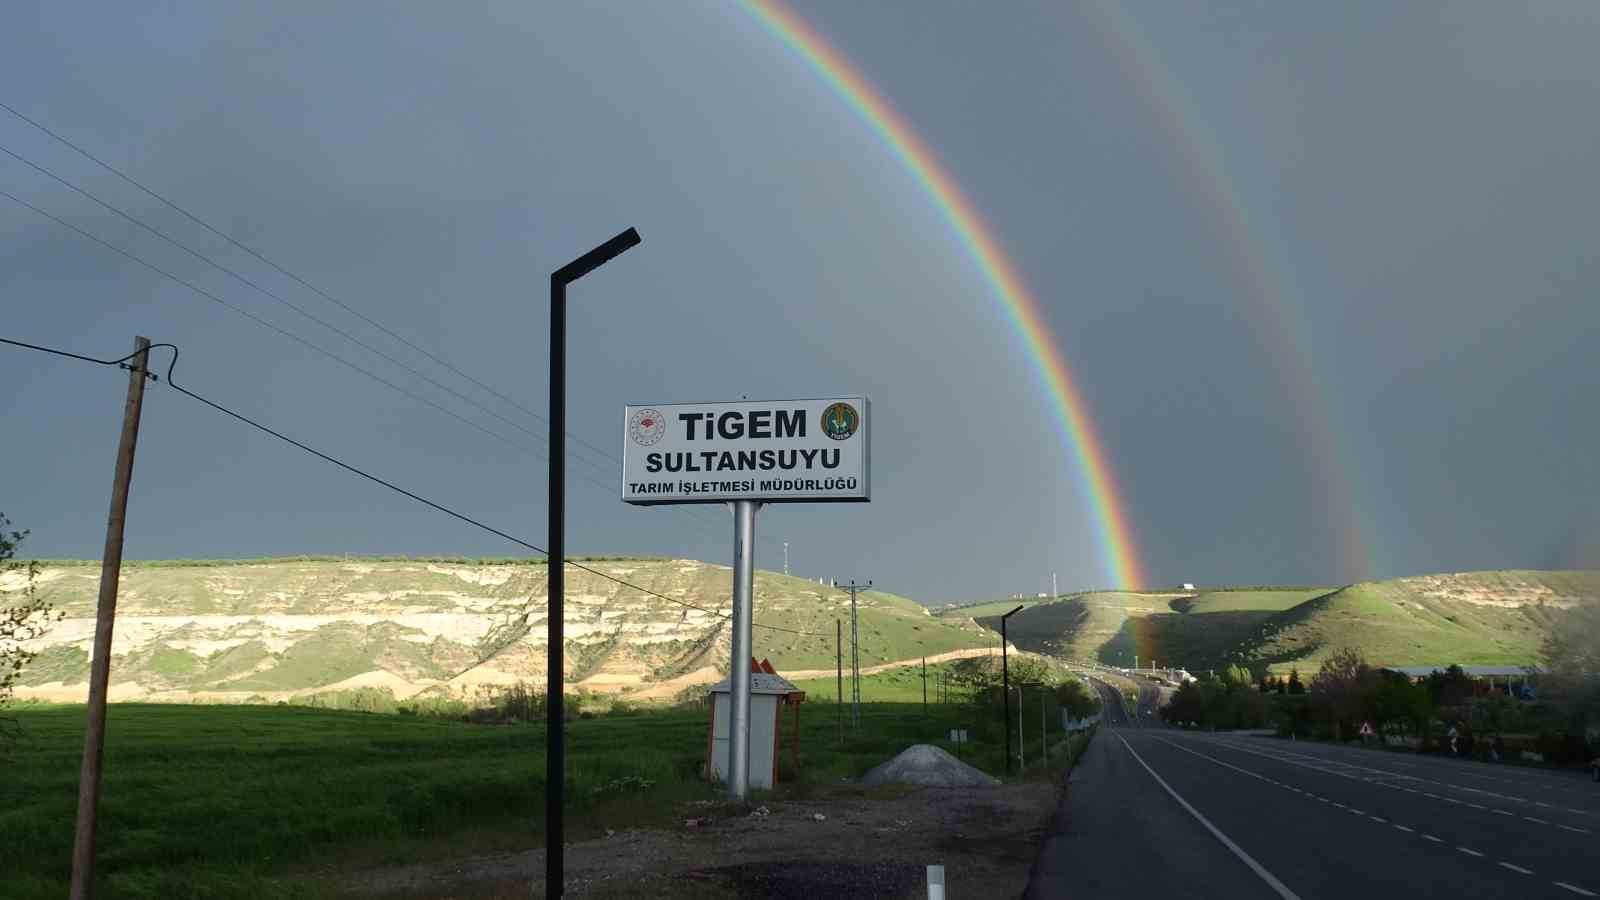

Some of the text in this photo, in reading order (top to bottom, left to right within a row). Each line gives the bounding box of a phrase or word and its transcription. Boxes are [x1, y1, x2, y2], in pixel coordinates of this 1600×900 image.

[646, 448, 840, 473] SULTANSUYU
[629, 476, 857, 495] TARIM İŞLETMESİ MÜDÜRLÜĞÜ
